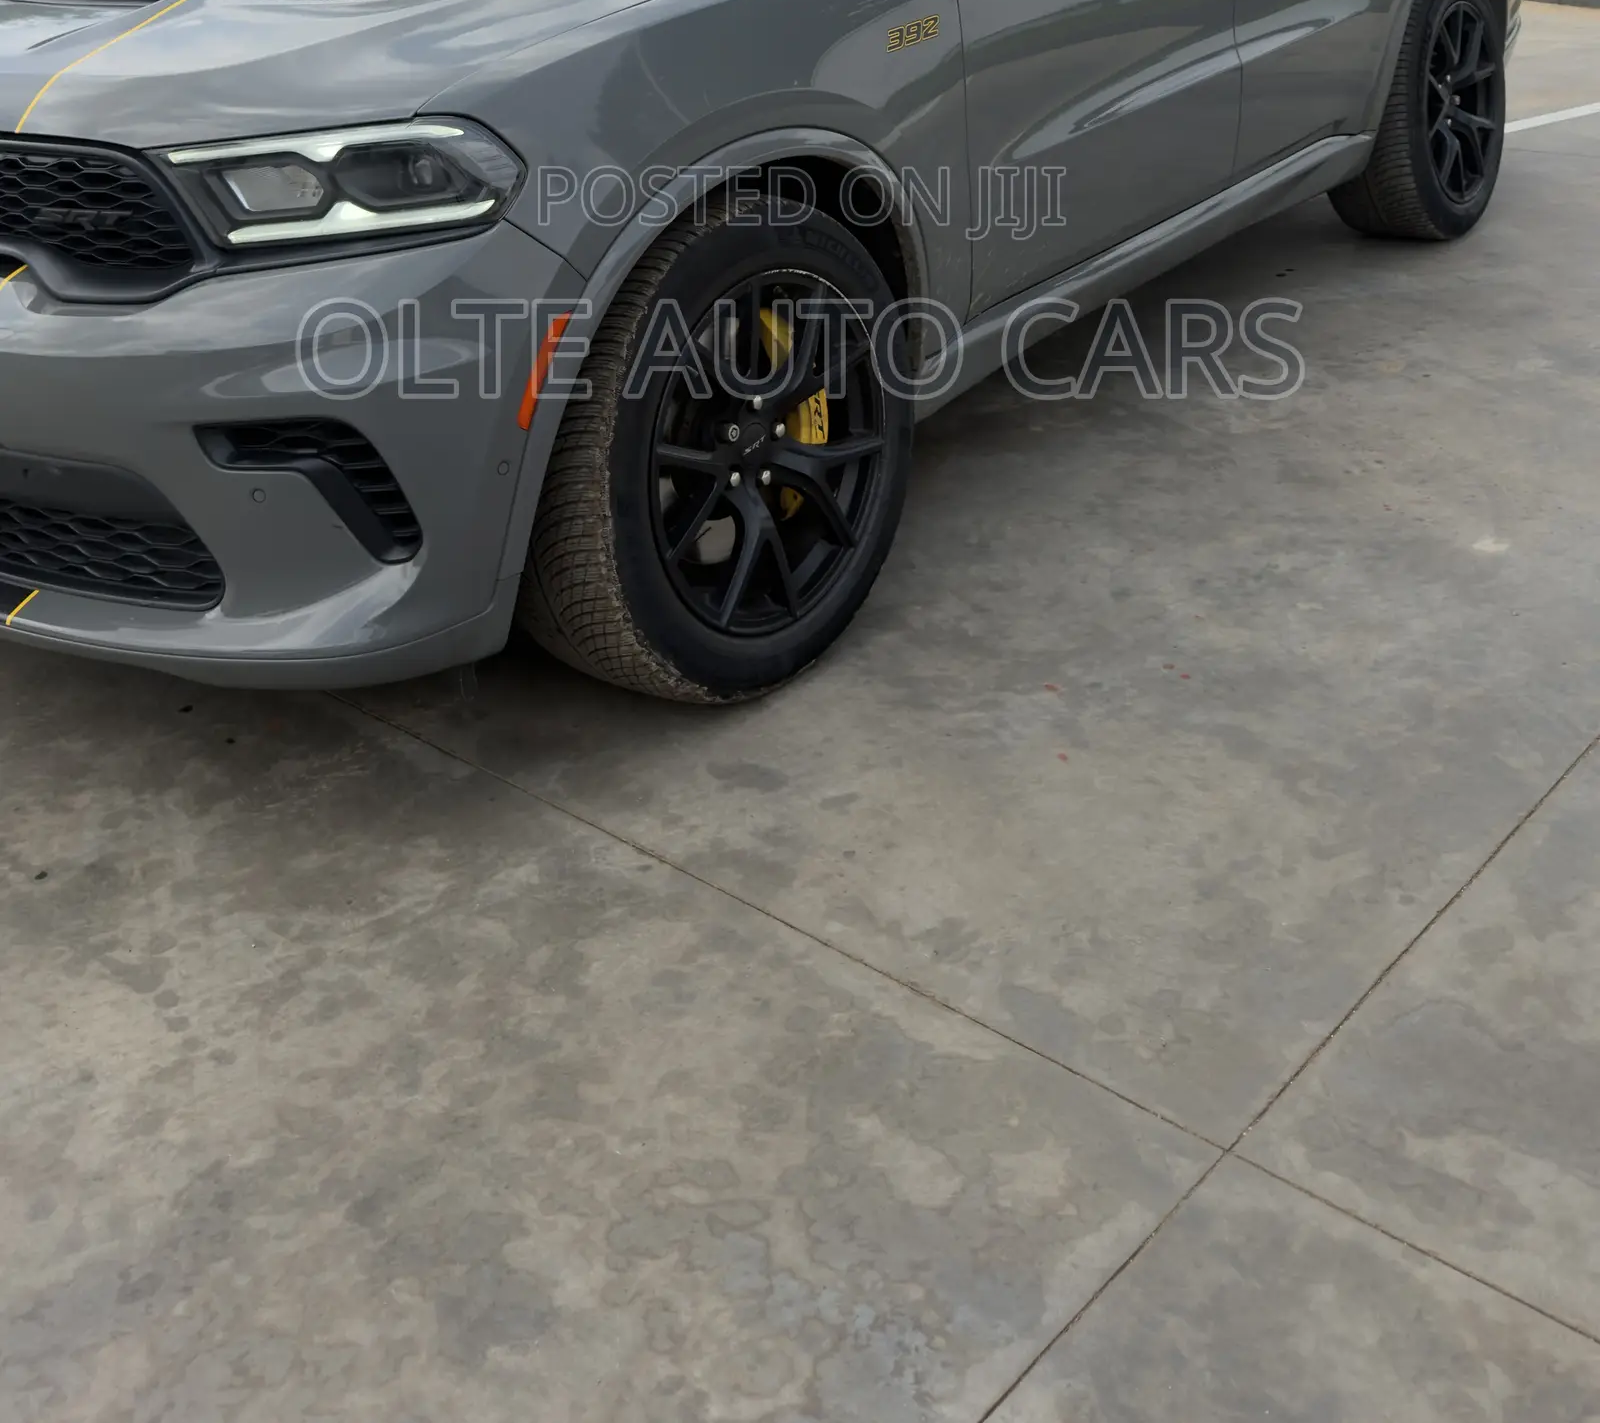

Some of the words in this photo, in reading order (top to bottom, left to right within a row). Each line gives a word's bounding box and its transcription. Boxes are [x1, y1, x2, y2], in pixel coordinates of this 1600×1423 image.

[886, 14, 940, 53] 392
[33, 207, 133, 231] SRT
[813, 390, 826, 440] RT
[742, 434, 767, 457] SRT
